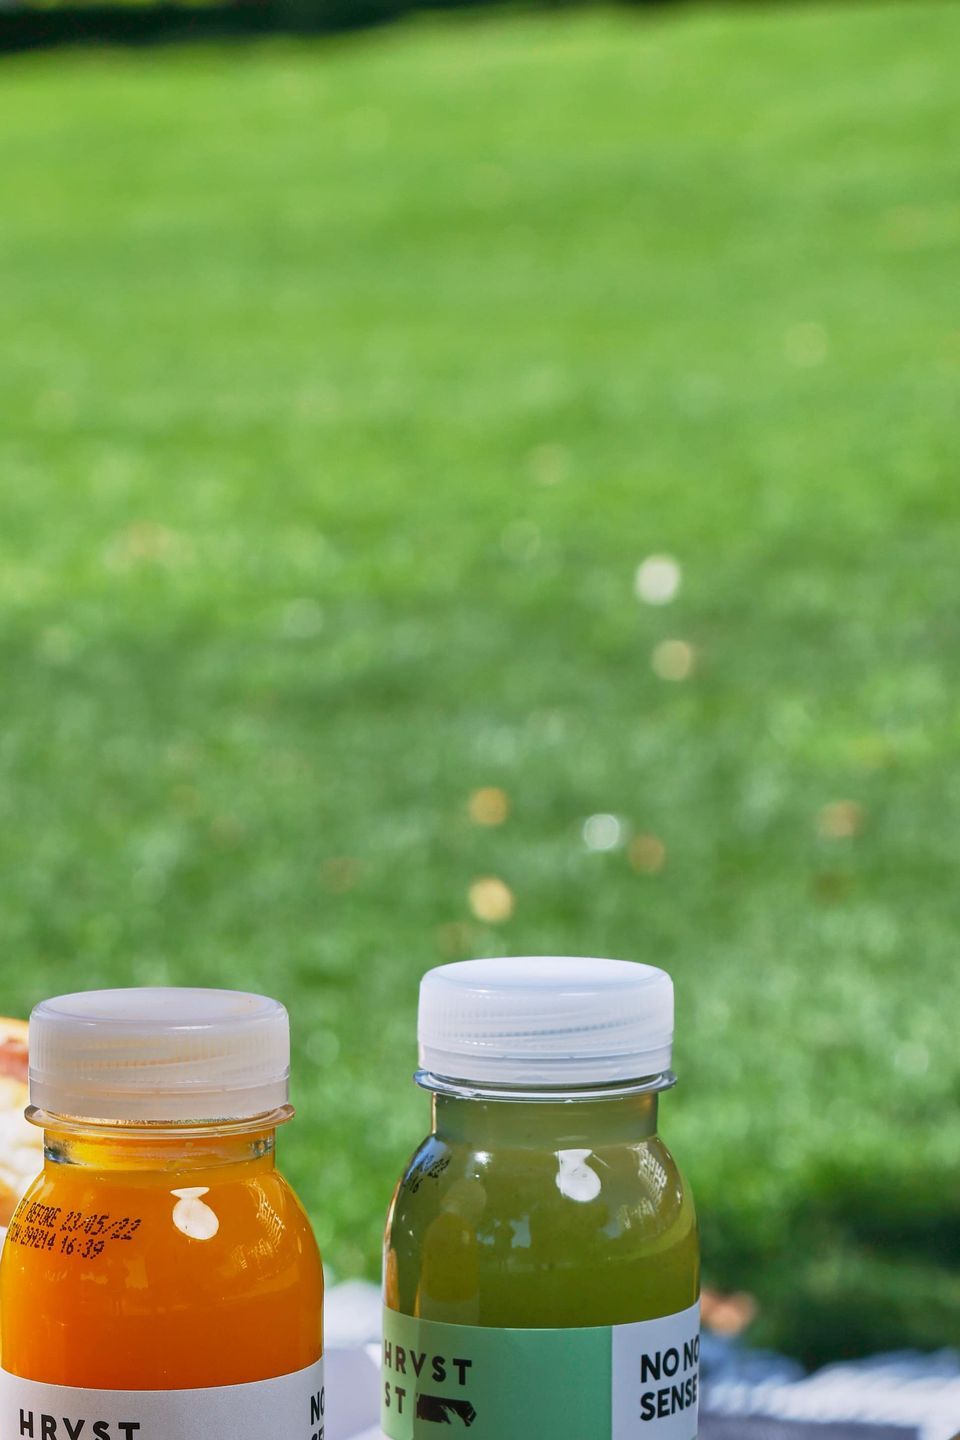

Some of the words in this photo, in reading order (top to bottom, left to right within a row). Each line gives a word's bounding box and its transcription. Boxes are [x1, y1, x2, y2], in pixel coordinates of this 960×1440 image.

[25, 1201, 62, 1228] BEFORE
[59, 1210, 142, 1240] 23/05/22
[60, 1234, 105, 1260] 16:39
[384, 1338, 473, 1386] HRVST
[641, 1347, 680, 1384] NO
[384, 1381, 406, 1414] ST
[640, 1373, 698, 1422] SENSE
